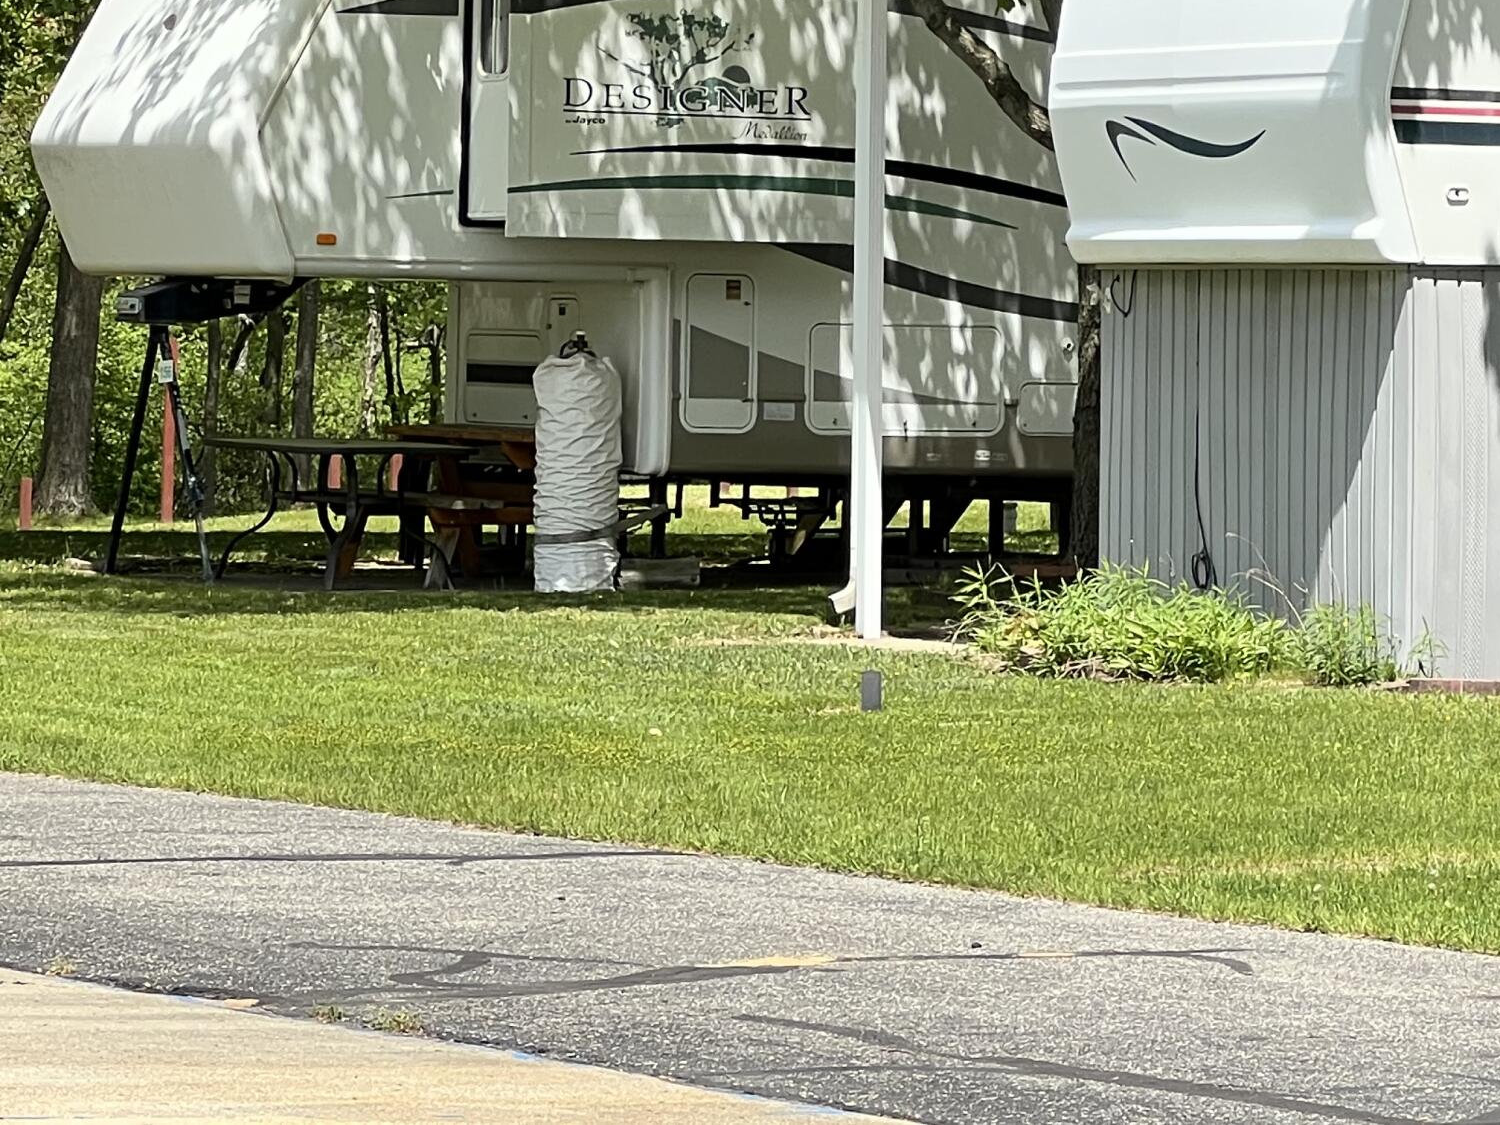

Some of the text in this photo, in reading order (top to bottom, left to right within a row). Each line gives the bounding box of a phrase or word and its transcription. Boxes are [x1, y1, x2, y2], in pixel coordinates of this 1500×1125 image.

[563, 77, 811, 116] DESIGNER
[572, 116, 606, 125] Jayco
[732, 121, 808, 141] Medallion
